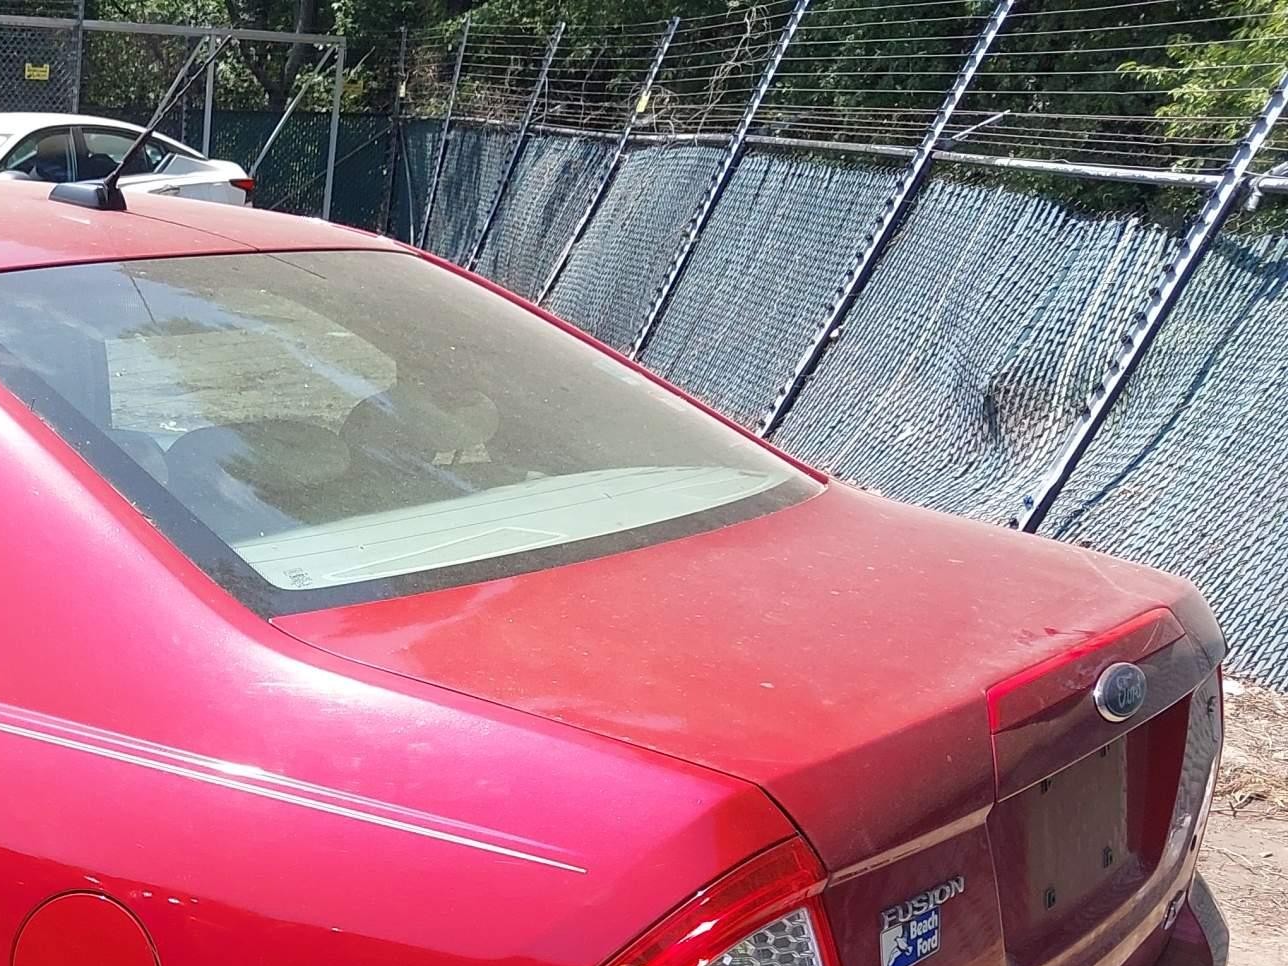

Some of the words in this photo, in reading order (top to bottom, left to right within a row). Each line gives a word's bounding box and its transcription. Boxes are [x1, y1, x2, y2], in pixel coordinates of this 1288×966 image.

[1116, 672, 1143, 709] Ford
[881, 876, 965, 930] FUSION
[910, 911, 938, 940] Beach
[916, 930, 938, 957] Ford
